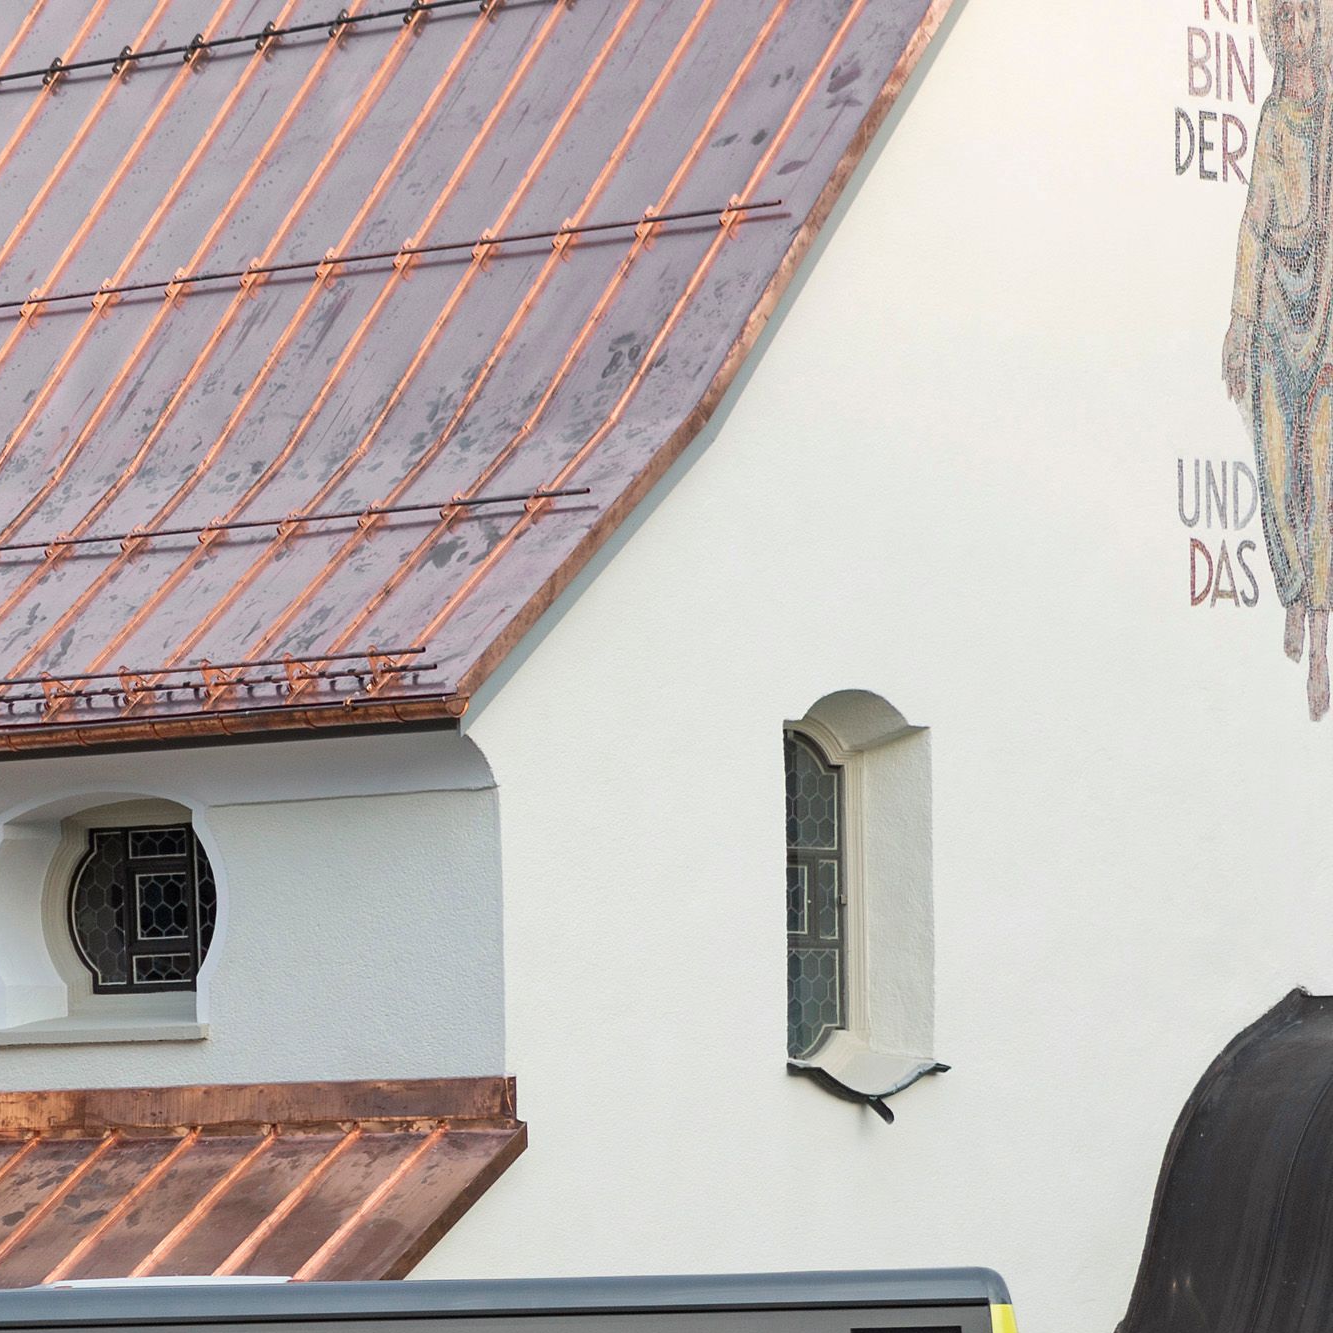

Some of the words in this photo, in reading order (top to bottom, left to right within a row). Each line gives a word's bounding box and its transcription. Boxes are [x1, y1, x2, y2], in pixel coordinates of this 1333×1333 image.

[1187, 26, 1255, 105] BIN
[1175, 107, 1249, 185] DER
[1178, 458, 1258, 530] UND
[1190, 537, 1259, 608] DAS
